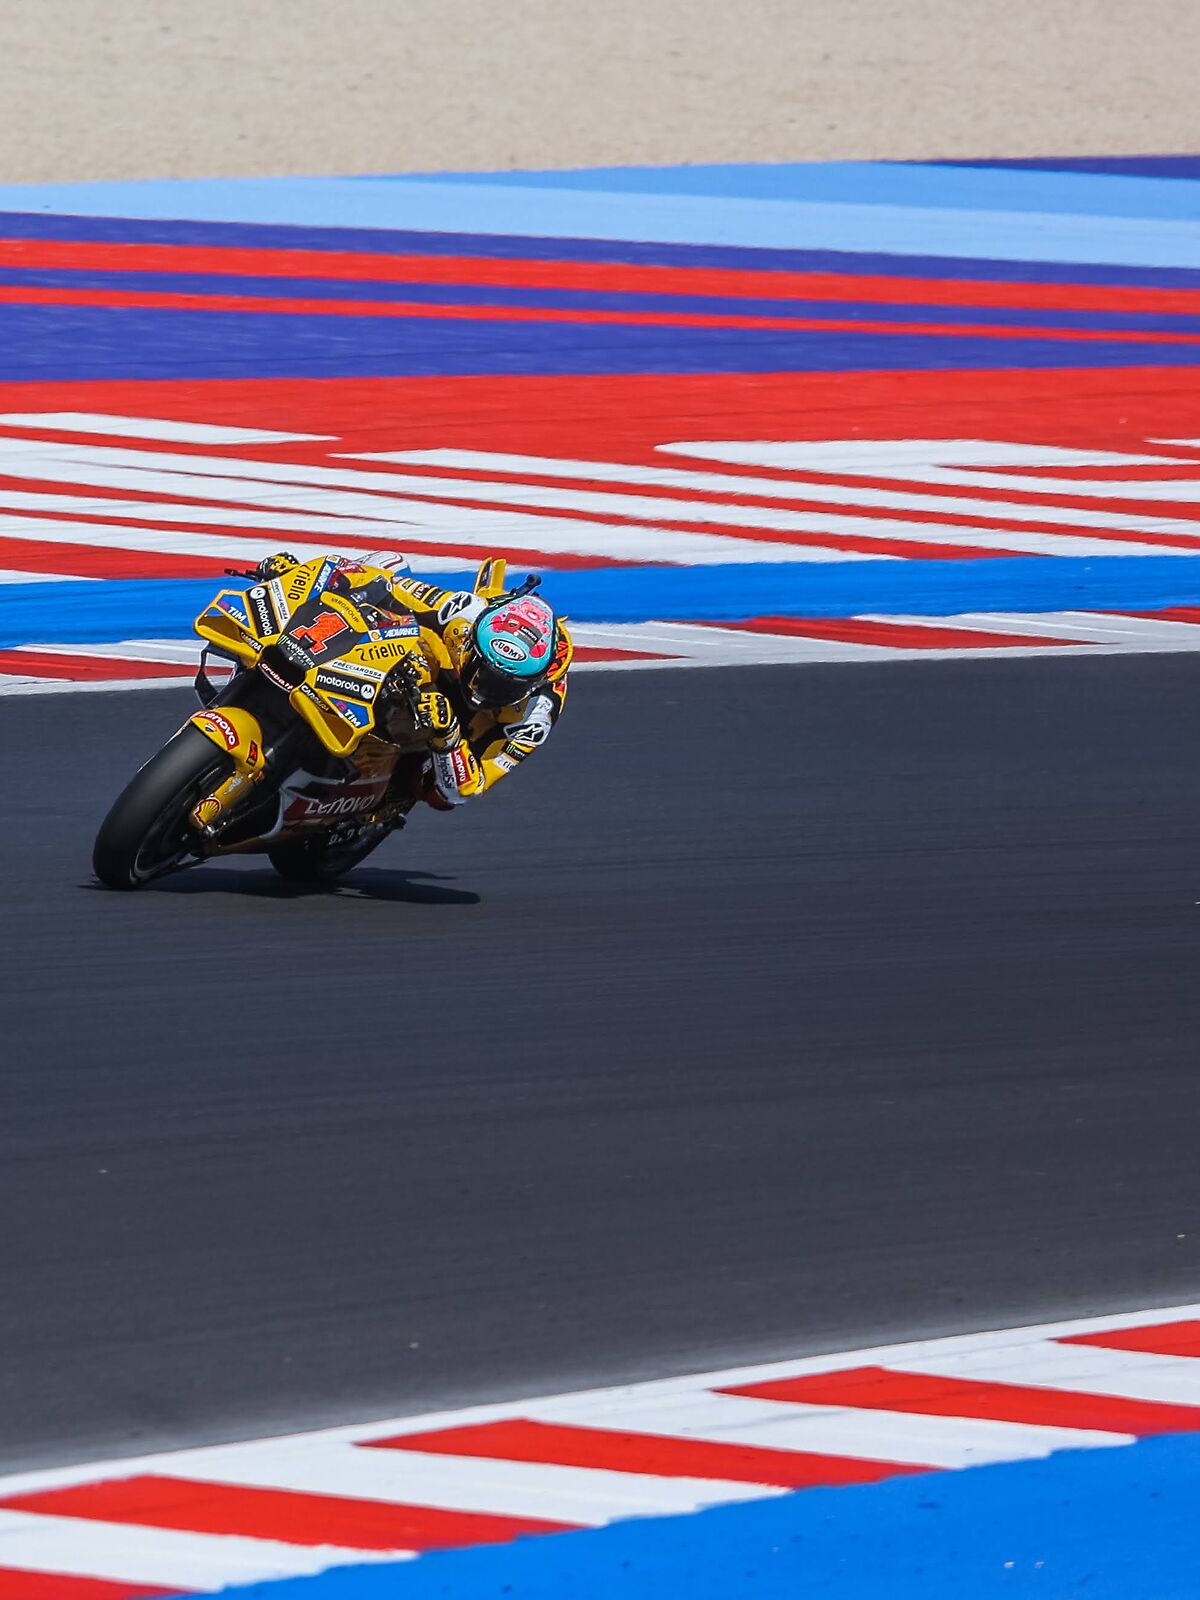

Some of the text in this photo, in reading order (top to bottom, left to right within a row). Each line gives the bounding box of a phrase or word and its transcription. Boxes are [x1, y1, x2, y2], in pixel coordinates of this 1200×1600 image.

[288, 569, 311, 600] riello
[227, 607, 247, 622] TIM
[256, 599, 272, 636] motorola
[289, 611, 349, 655] 1
[384, 627, 419, 638] ADVANCE
[369, 643, 406, 661] riello
[493, 640, 523, 660] SUOMY
[334, 661, 382, 677] FRECCIAROSSA
[316, 674, 360, 692] motorola
[198, 711, 236, 745] Lenovo
[344, 709, 361, 727] TIM
[454, 749, 466, 782] Lenovo
[305, 794, 376, 814] Lenovo
